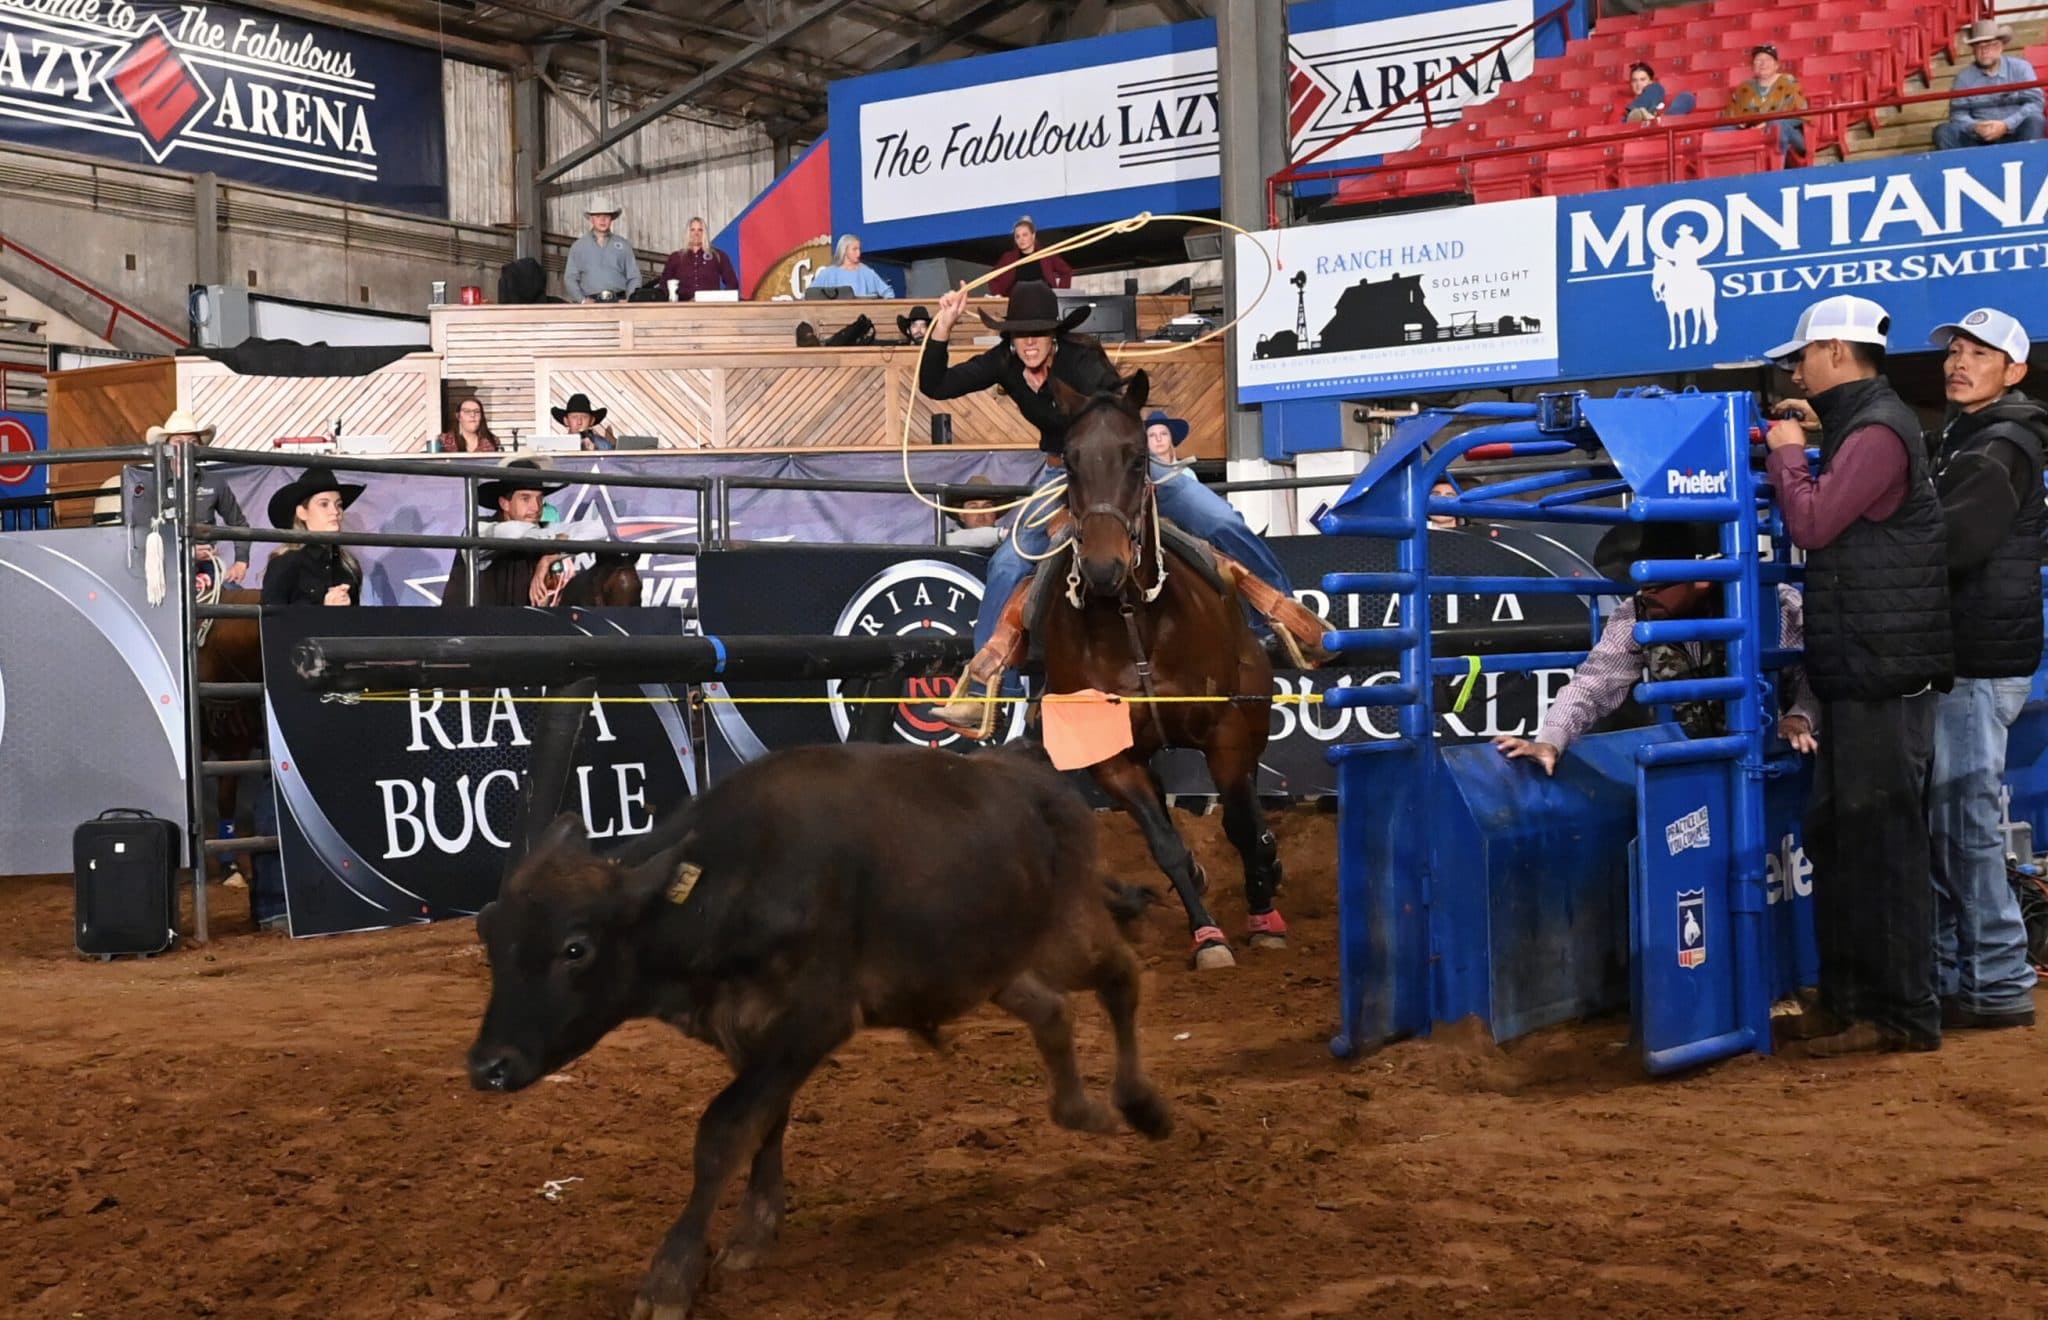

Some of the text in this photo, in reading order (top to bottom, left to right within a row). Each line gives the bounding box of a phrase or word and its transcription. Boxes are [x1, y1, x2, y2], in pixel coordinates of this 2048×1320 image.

[177, 5, 356, 78] The Fabulous
[213, 77, 377, 156] ARENA
[873, 128, 932, 180] The
[940, 109, 1112, 170] Fabulous
[1341, 47, 1512, 114] ARENA
[1316, 239, 1465, 276] RANCH HAND
[1431, 268, 1530, 290] SOLAR LIGHT
[1451, 287, 1511, 303] SYSTEM
[1667, 467, 1728, 494] Priefert
[858, 581, 979, 637] RIAT
[405, 685, 617, 751] RIAA
[375, 762, 654, 859] BUCLE
